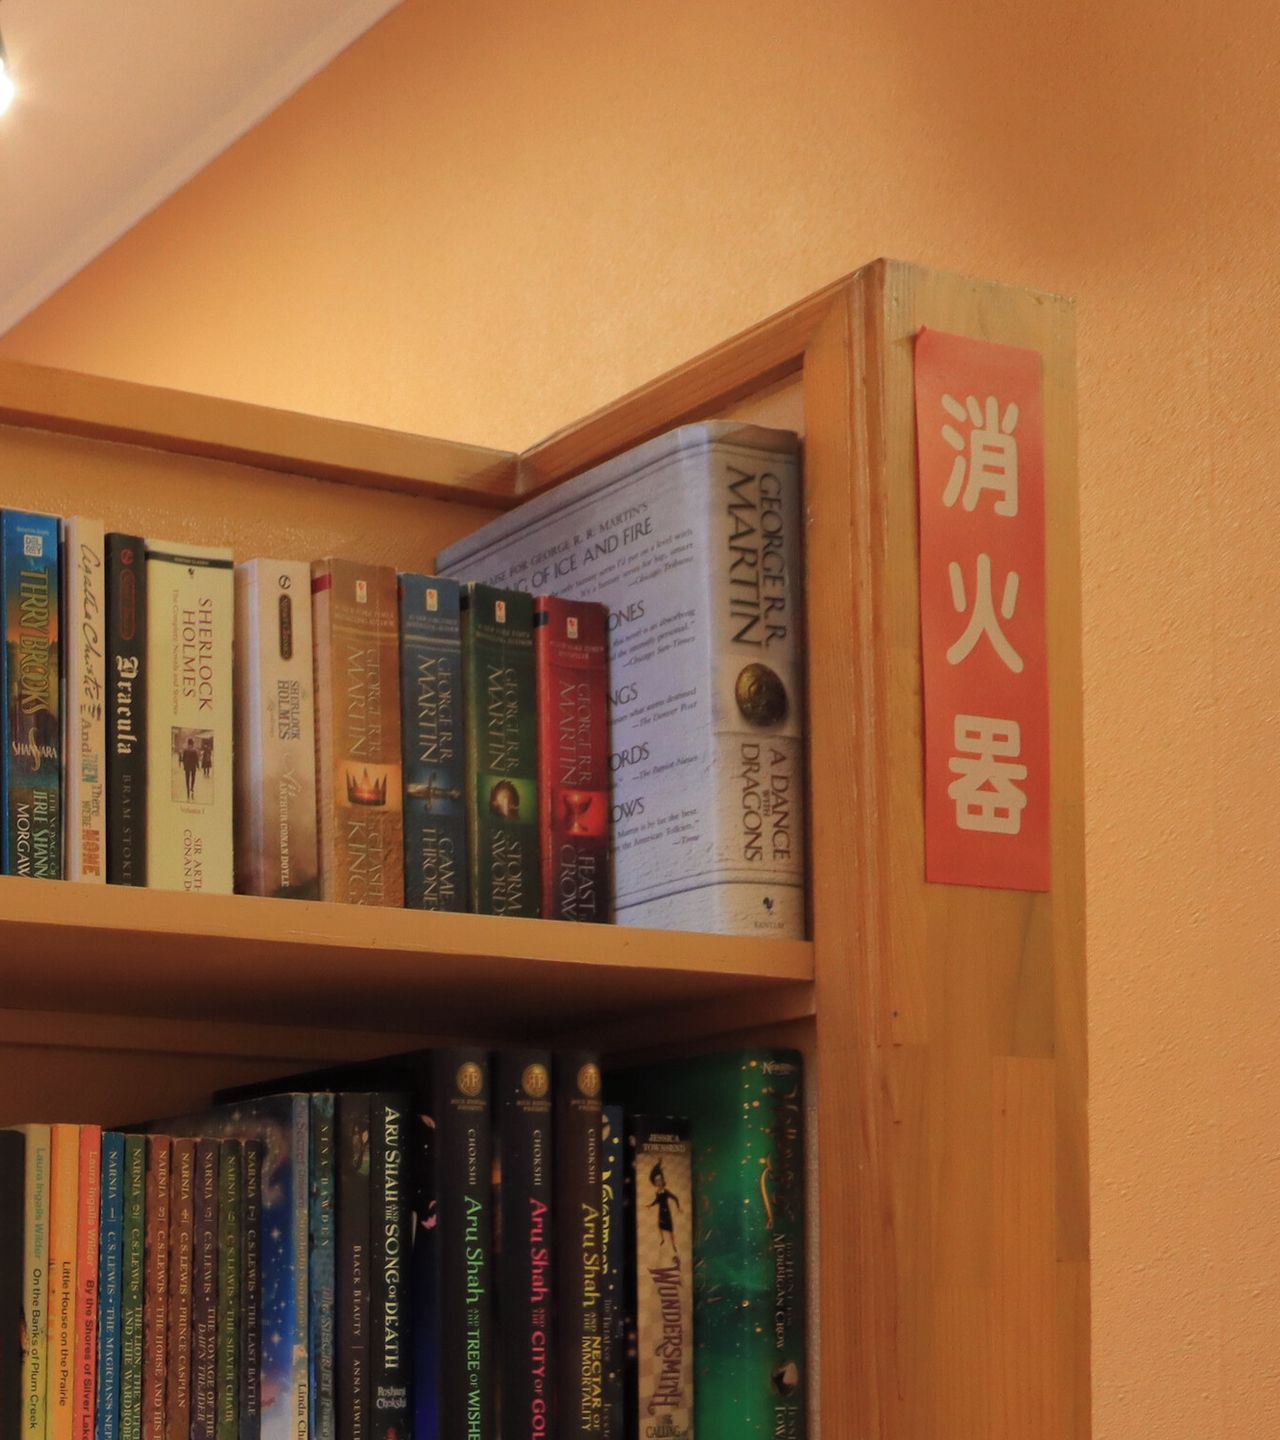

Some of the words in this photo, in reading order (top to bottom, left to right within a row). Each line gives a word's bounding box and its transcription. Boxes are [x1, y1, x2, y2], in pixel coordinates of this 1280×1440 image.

[726, 464, 762, 650] MARTIN
[759, 473, 787, 582] GEORGE
[21, 567, 49, 636] TERRY
[942, 392, 1028, 835] 消火器
[21, 642, 50, 716] BROOKS
[182, 609, 196, 698] HOLMES
[198, 597, 213, 711] SHERLOCK
[115, 656, 137, 755] Dracula
[418, 655, 439, 763] MARTIN
[488, 665, 507, 771] MARTIN
[560, 681, 576, 787] MARTIN
[739, 743, 763, 861] DRAGONS
[770, 770, 791, 861] DANCE
[107, 1150, 117, 1200] NARNIA
[384, 1150, 401, 1202] SHAH
[465, 1195, 484, 1242] Aru
[384, 1299, 400, 1369] DEATH
[530, 1330, 547, 1377] CITY
[591, 1335, 603, 1408] NECTAR
